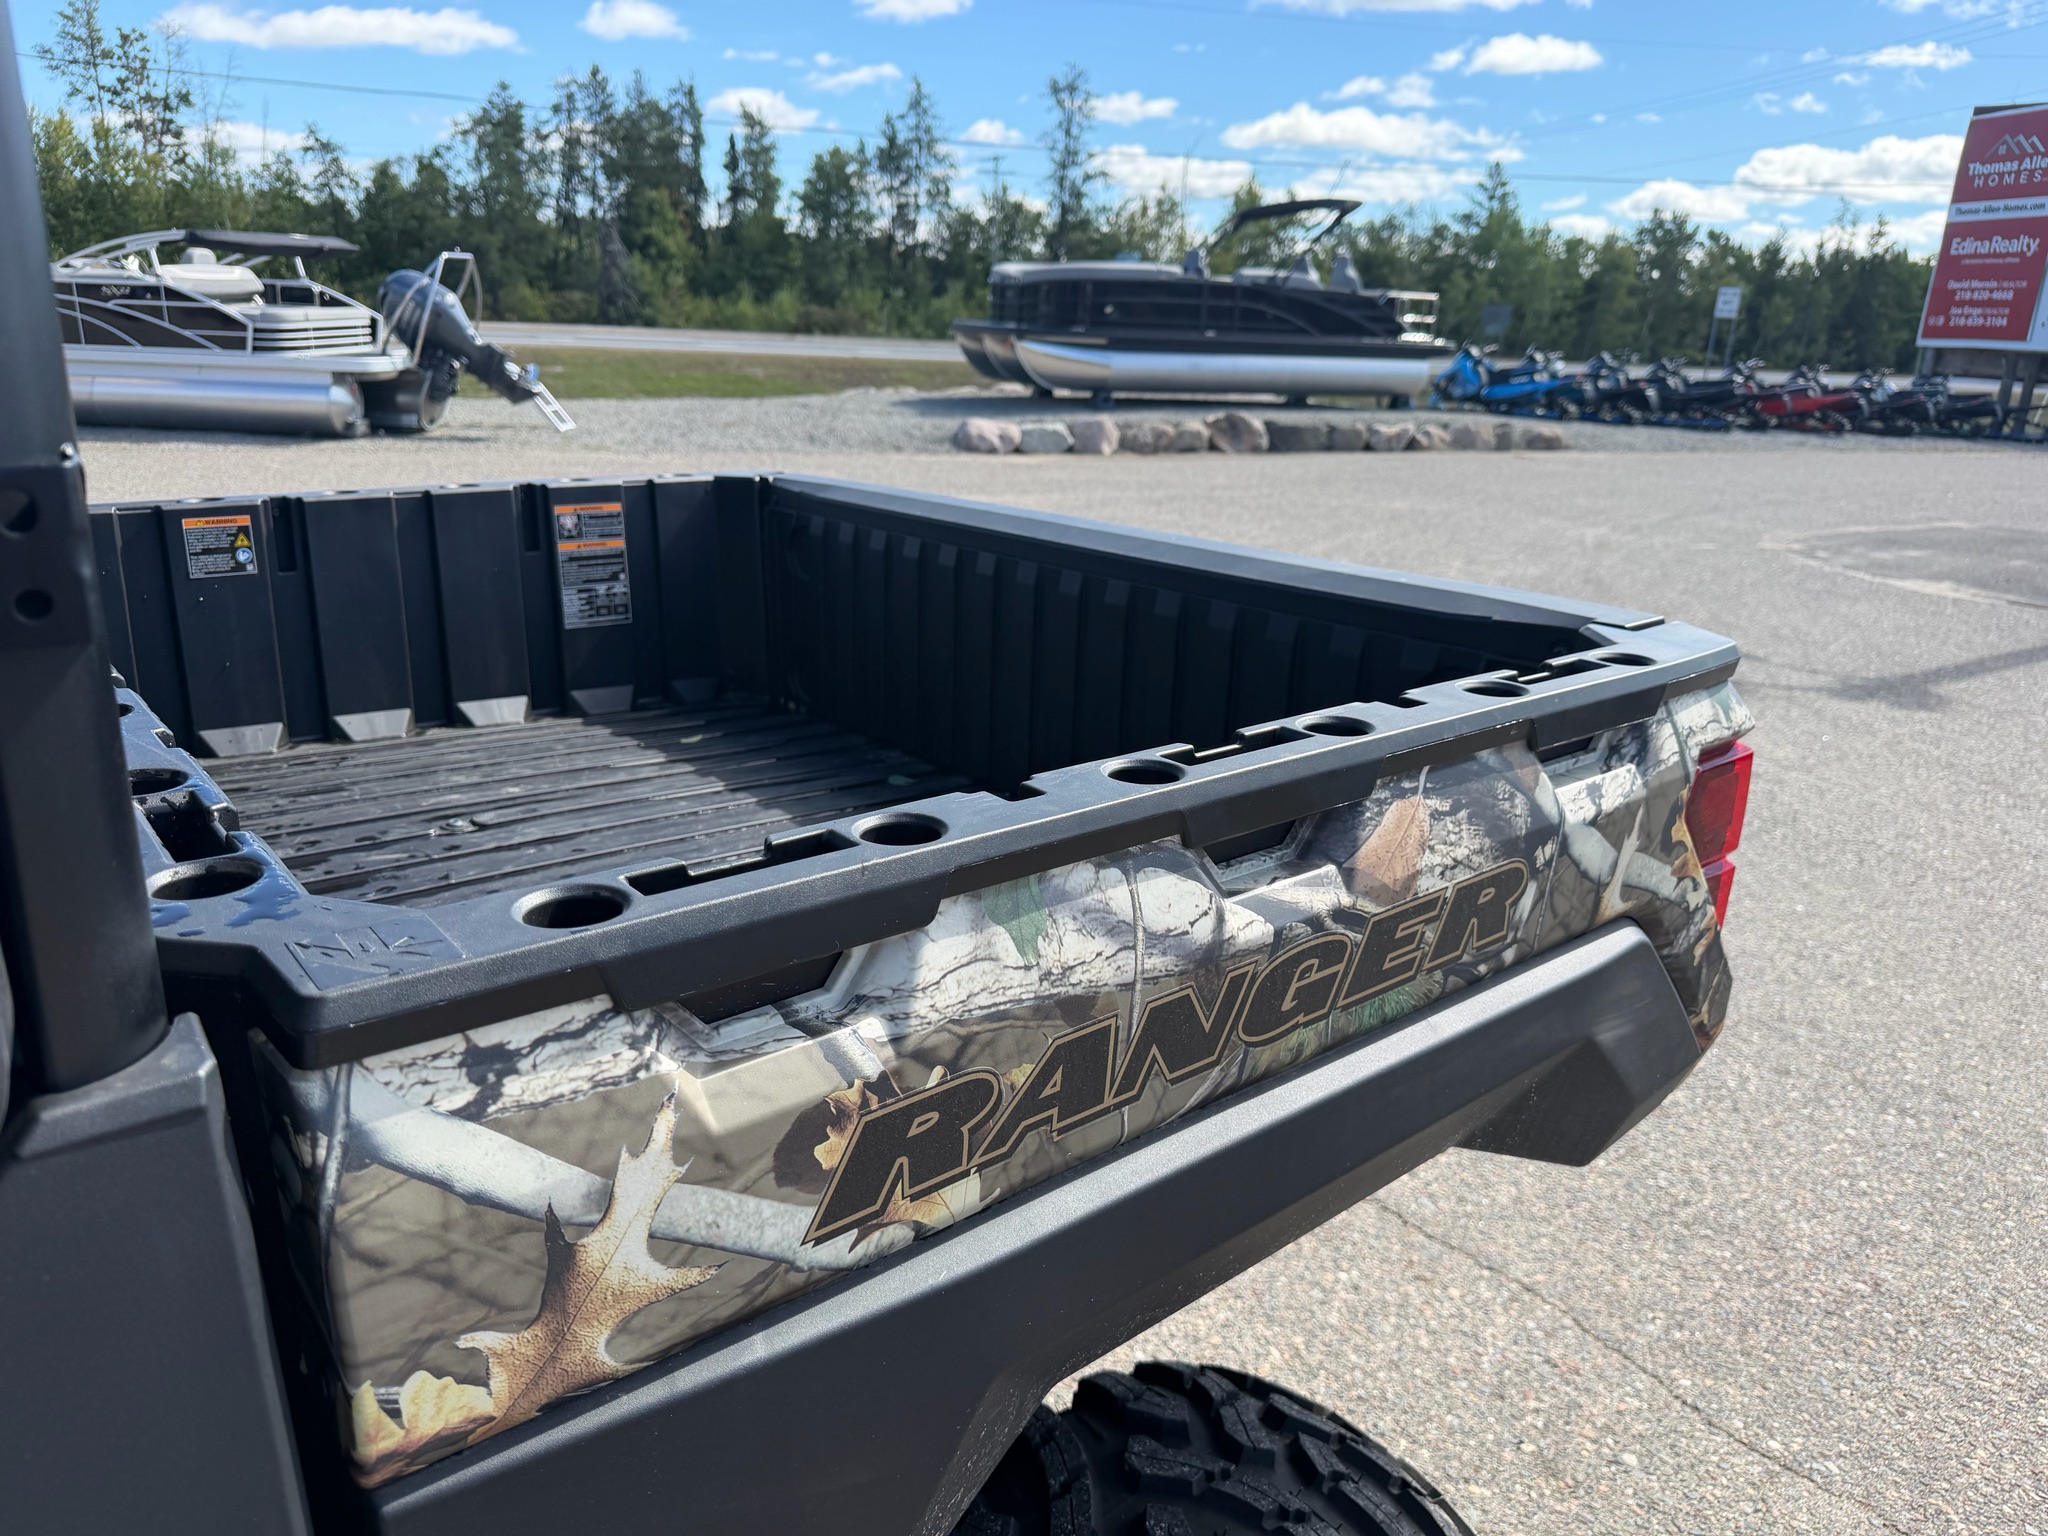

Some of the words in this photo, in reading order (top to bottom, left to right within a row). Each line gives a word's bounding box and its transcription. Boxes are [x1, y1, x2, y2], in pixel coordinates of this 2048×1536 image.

[1968, 161, 2019, 176] Thomas
[1973, 170, 2043, 189] HOMES
[204, 517, 238, 526] WARNING
[800, 858, 1530, 1247] RANGER
